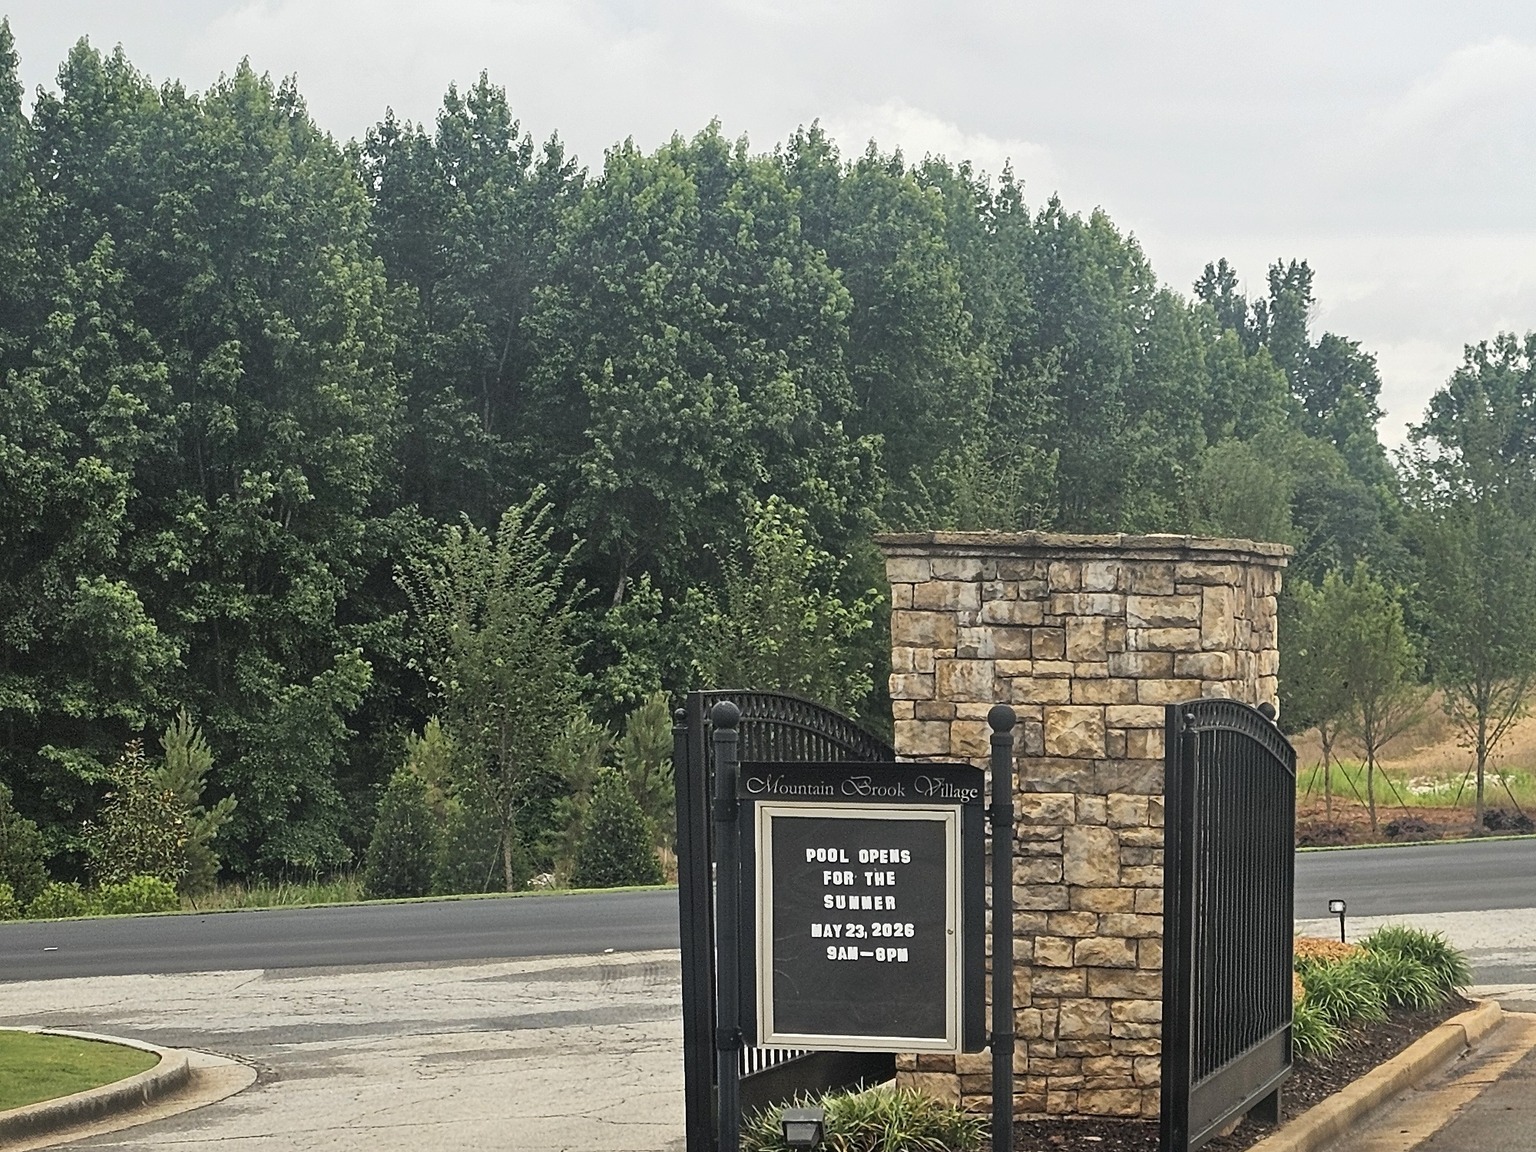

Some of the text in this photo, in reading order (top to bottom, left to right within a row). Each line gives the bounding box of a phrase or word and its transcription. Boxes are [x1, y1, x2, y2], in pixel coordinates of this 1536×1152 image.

[746, 774, 978, 803] Mountain Brook Village
[806, 848, 911, 864] POOL OPENS
[823, 871, 896, 886] FOR THE
[824, 894, 896, 911] SUMMER
[811, 922, 915, 939] MAY 23, 2026
